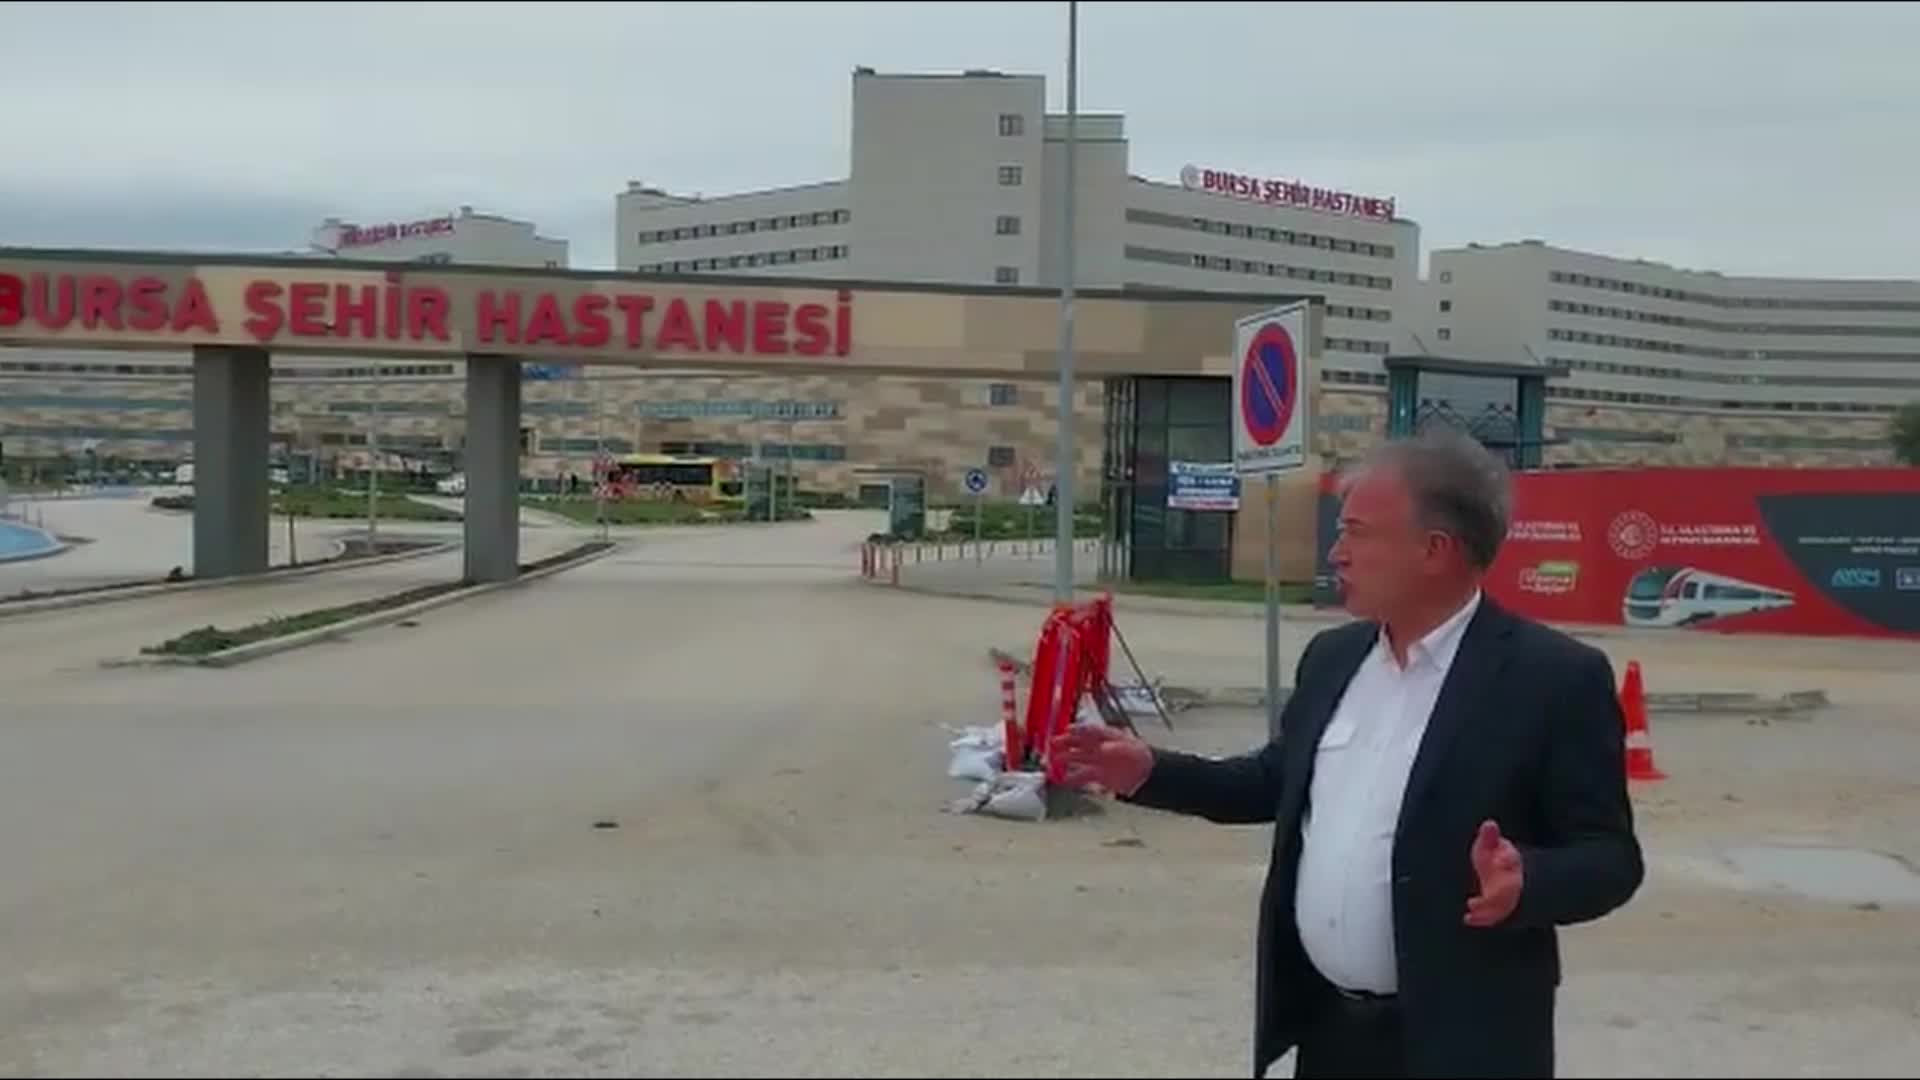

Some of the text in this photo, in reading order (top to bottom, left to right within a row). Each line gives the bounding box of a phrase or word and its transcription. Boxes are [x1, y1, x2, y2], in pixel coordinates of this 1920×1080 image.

[1203, 169, 1260, 198] BURSA
[244, 270, 450, 342] ŞEHİR
[476, 289, 852, 357] HASTANESİ
